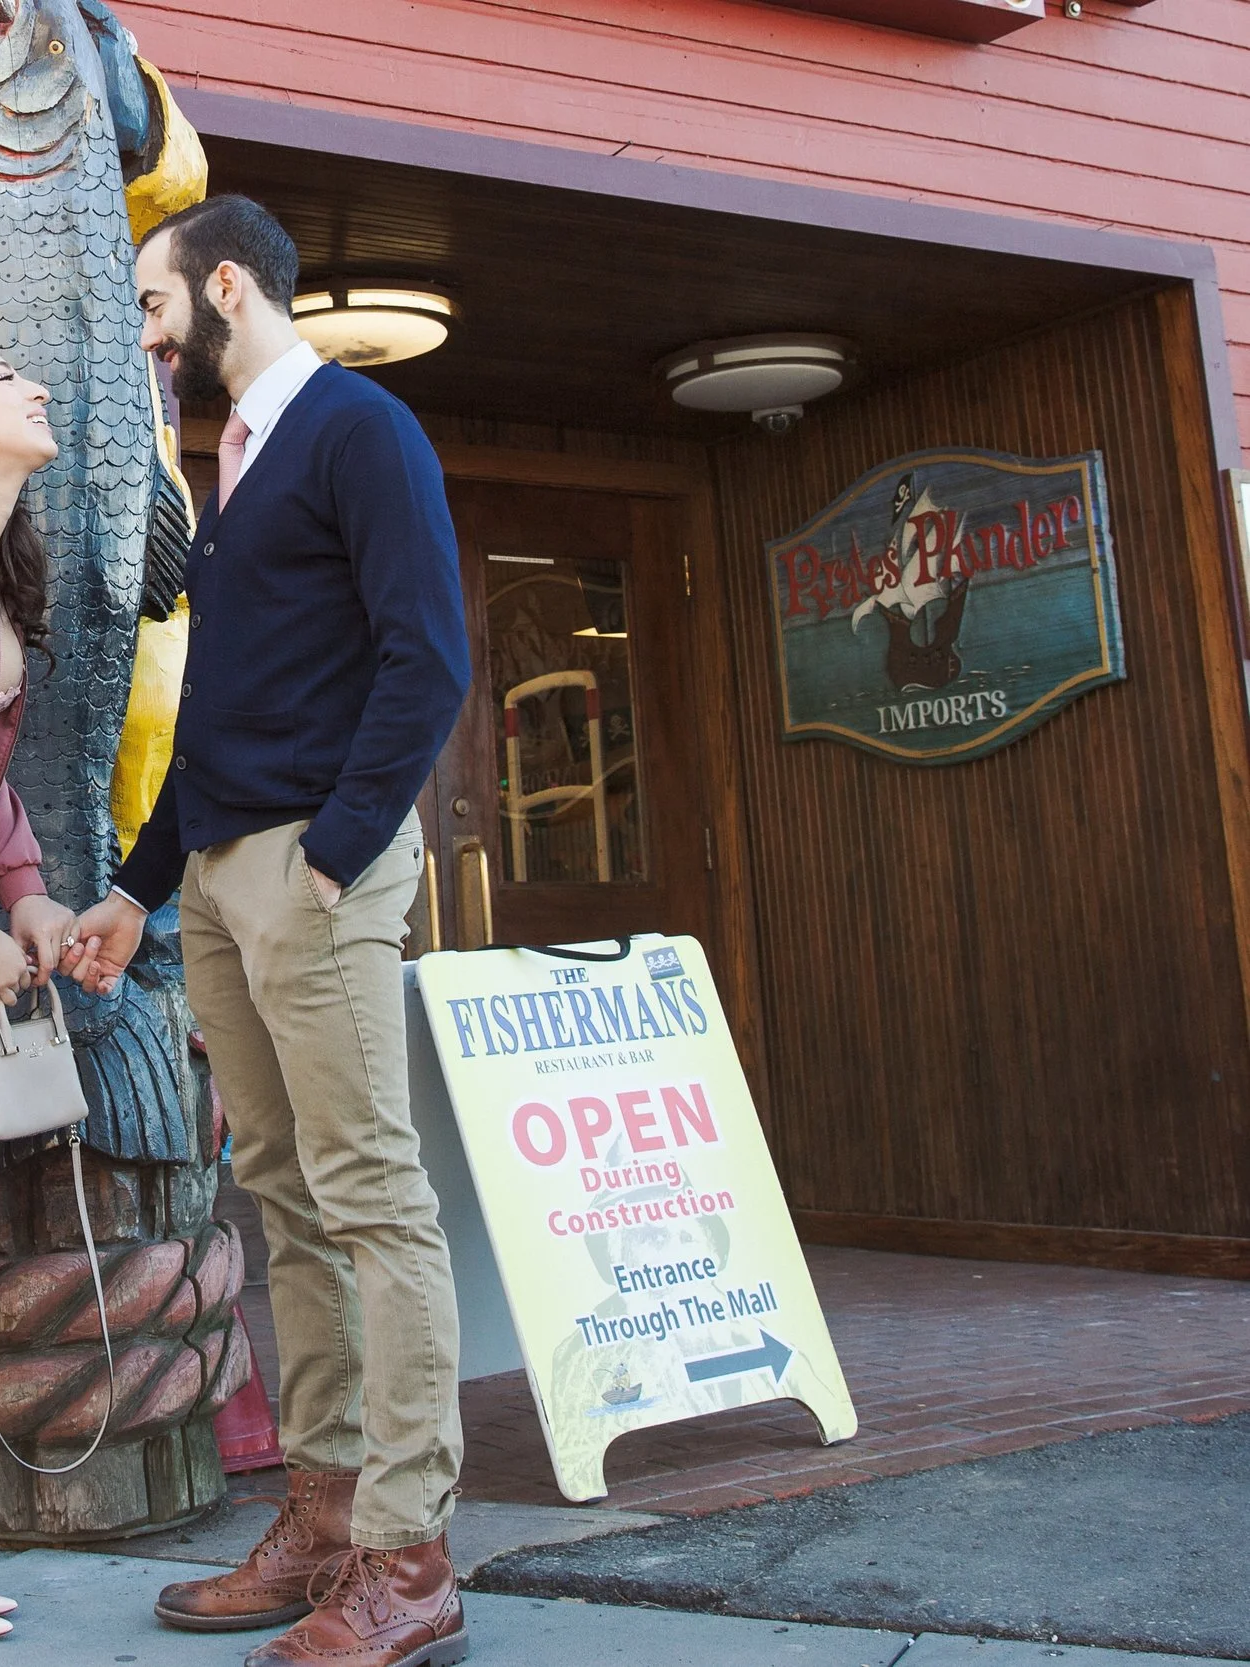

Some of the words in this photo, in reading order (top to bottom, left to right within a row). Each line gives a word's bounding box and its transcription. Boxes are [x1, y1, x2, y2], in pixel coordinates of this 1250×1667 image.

[877, 689, 1007, 733] IMPORTS
[550, 967, 589, 985] THE
[446, 977, 707, 1058] FISHERMANS
[534, 1053, 614, 1074] RESTAURANT
[617, 1053, 629, 1066] &
[630, 1049, 655, 1064] BAR
[512, 1083, 719, 1167] OPEN
[580, 1159, 682, 1193] During
[548, 1189, 735, 1236] Construction
[613, 1256, 717, 1293] Entrance
[575, 1302, 680, 1346] Through
[679, 1296, 725, 1326] The
[726, 1282, 778, 1318] Mall
